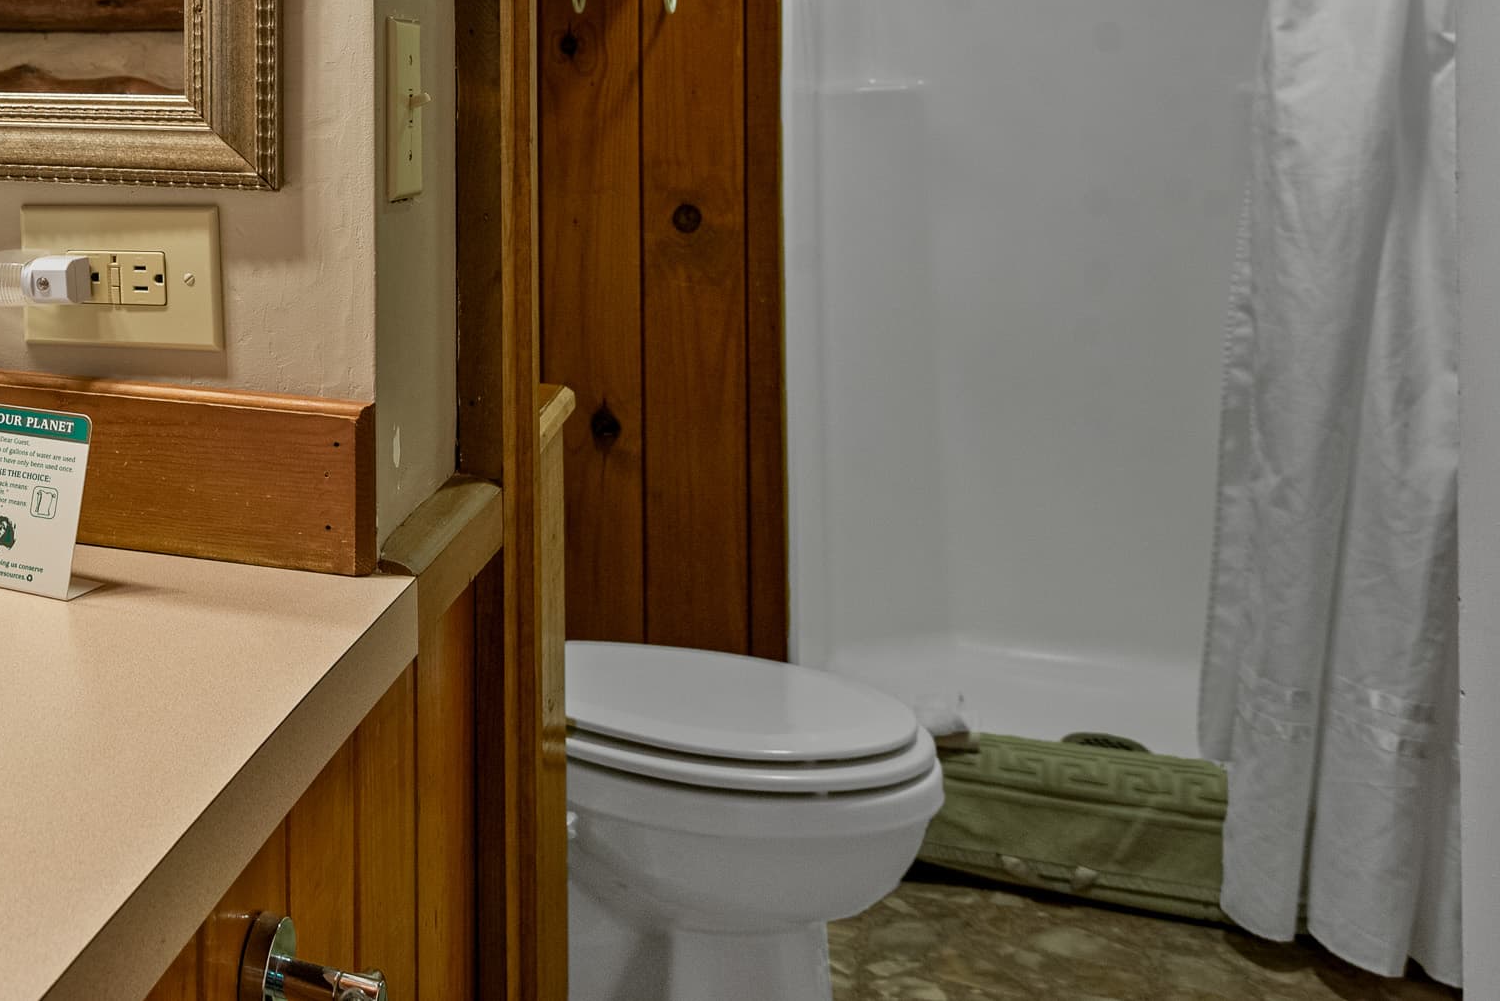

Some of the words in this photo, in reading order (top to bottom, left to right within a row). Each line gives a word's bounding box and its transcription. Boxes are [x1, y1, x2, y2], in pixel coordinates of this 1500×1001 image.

[26, 416, 74, 433] PLANET
[9, 447, 28, 456] gallons
[17, 459, 30, 468] only
[8, 469, 21, 478] THE
[22, 471, 52, 482] CHOICE:
[18, 563, 44, 574] conserve
